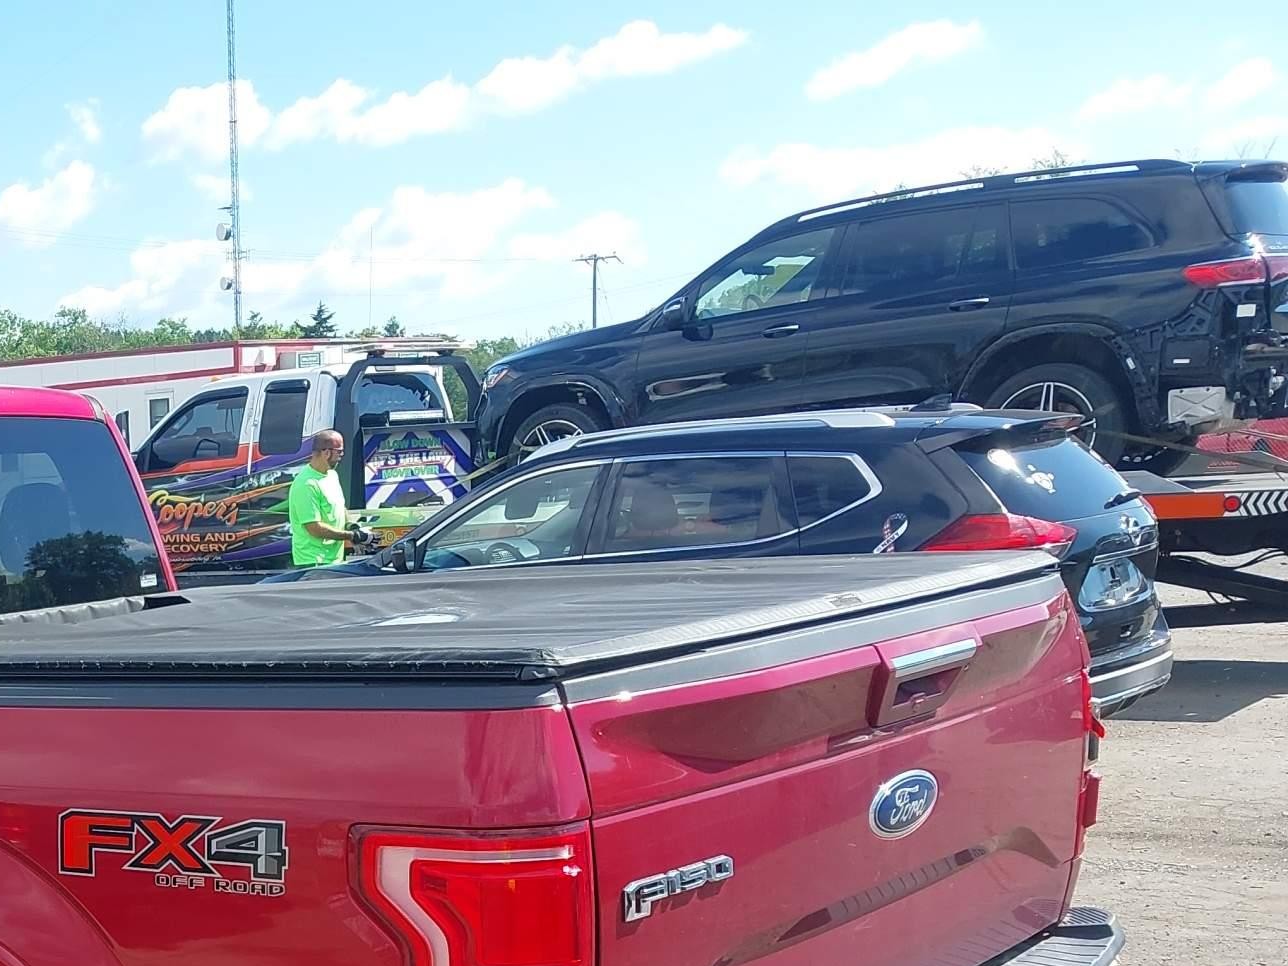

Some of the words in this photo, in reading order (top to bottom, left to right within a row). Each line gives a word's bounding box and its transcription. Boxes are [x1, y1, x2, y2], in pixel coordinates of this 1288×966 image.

[399, 453, 420, 465] THE
[382, 467, 411, 479] MOVE
[414, 465, 439, 476] OVER
[161, 532, 201, 543] WING
[204, 532, 236, 542] AND
[164, 543, 228, 553] ECOVERY
[58, 807, 289, 883] FX4
[155, 873, 205, 889] OFF
[214, 878, 286, 897] ROAD
